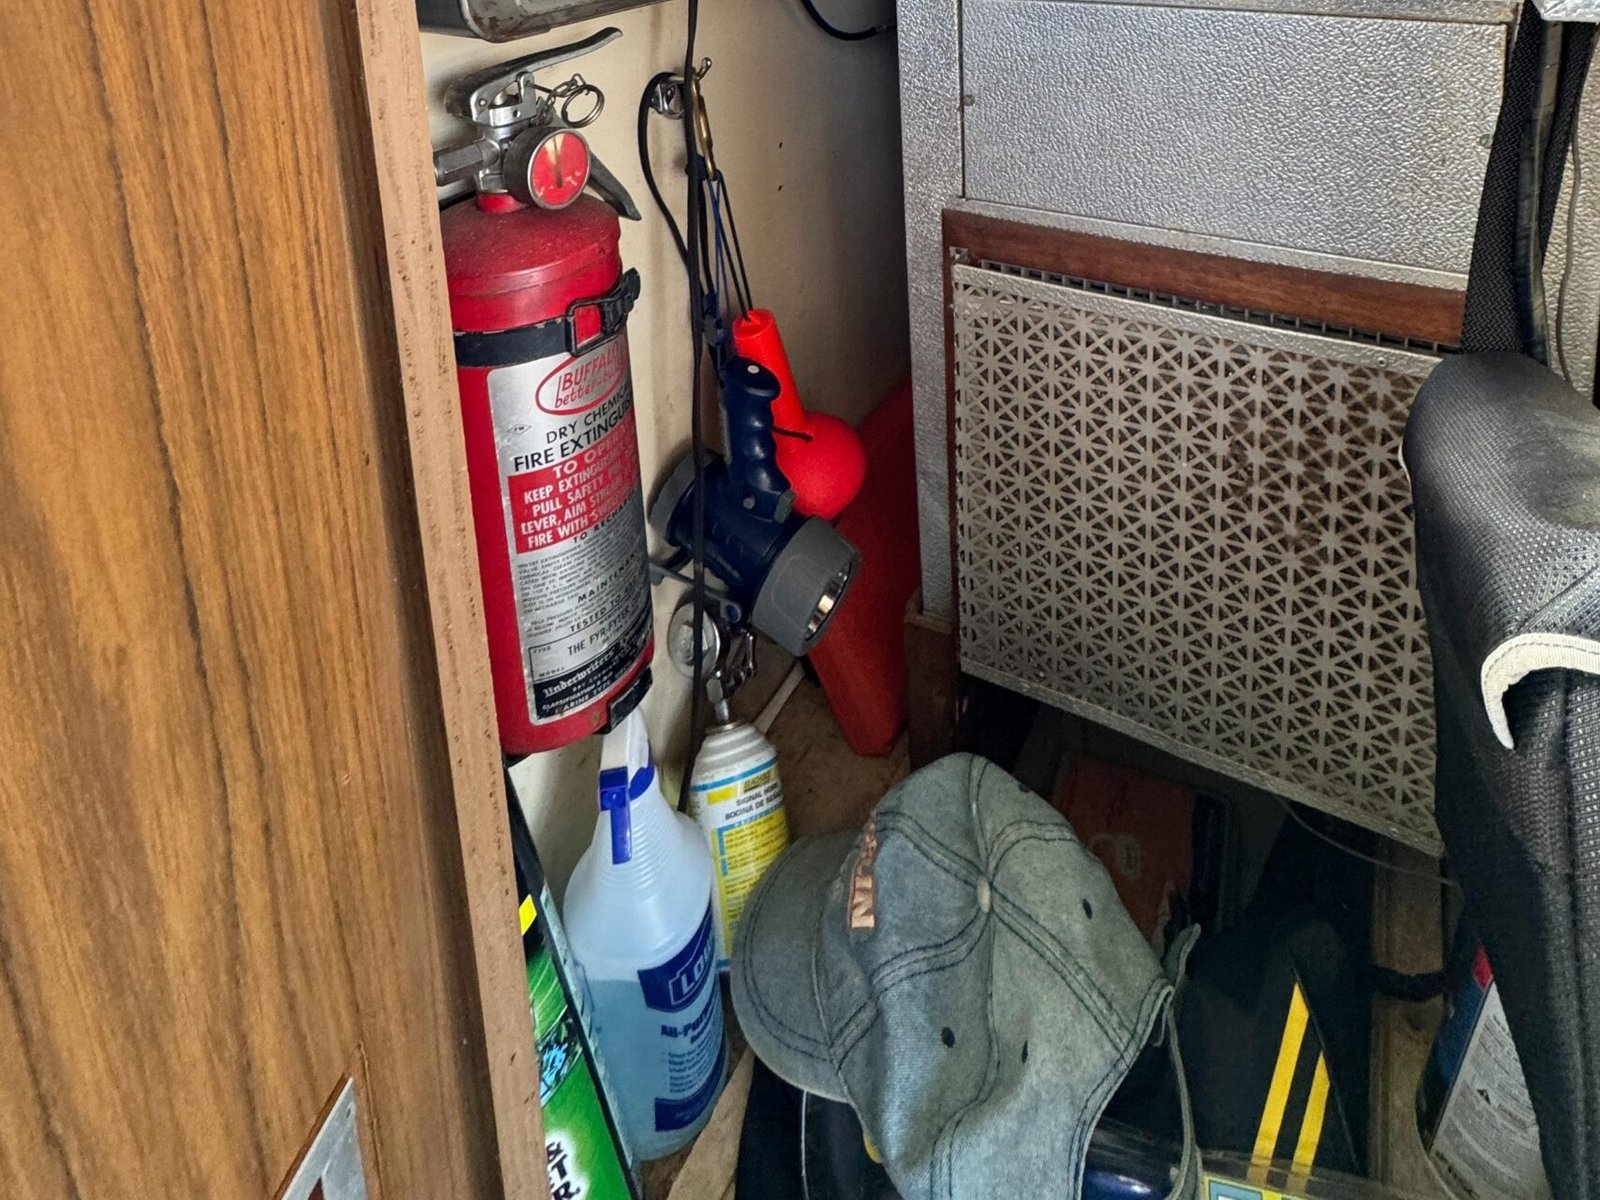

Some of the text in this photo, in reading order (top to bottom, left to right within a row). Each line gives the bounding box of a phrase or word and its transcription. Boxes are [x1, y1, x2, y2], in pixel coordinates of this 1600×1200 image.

[546, 420, 578, 444] DRY
[513, 447, 555, 472] FIRE
[552, 459, 578, 480] TO
[523, 484, 554, 505] KEEP
[532, 473, 605, 518] PULL SAFETY
[520, 513, 562, 536] LEVER,
[564, 501, 587, 522] AIM
[527, 530, 554, 549] FIRE
[557, 514, 589, 539] WITH
[572, 532, 588, 545] TO
[570, 606, 608, 633] TESTED
[567, 641, 587, 657] THE
[755, 800, 765, 810] DE
